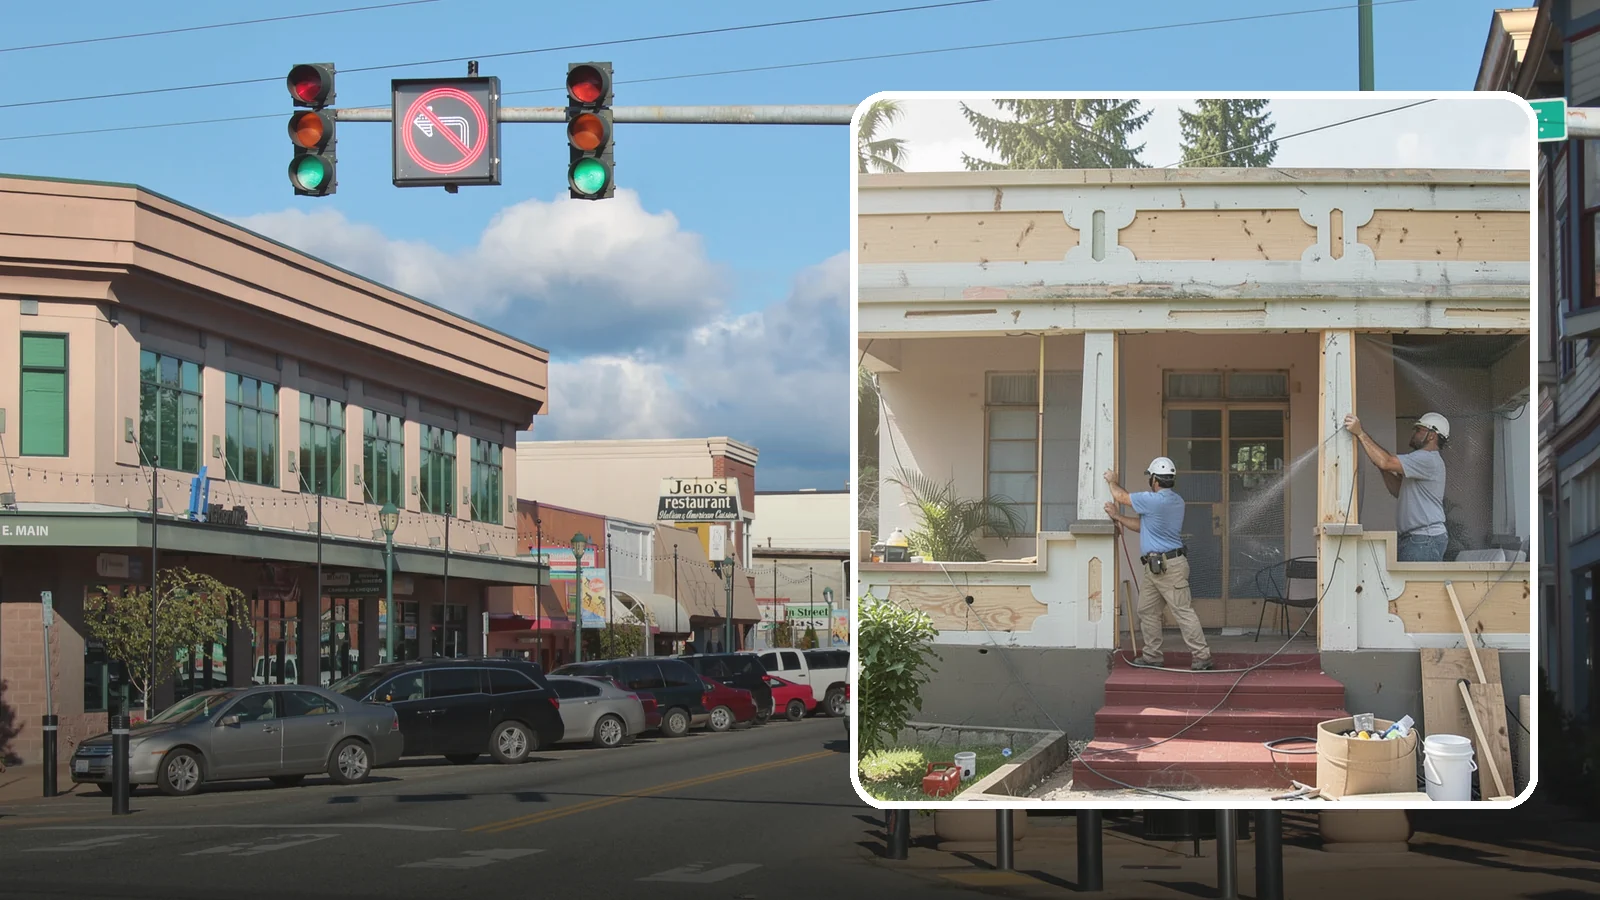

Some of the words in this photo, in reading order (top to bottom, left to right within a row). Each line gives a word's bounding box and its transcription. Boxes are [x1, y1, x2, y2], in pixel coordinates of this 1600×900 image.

[669, 480, 728, 494] Jeno's
[664, 496, 731, 509] restaurant
[715, 510, 738, 519] Cuisine
[2, 525, 13, 536] E.
[15, 525, 49, 536] MAIN
[797, 607, 828, 617] Street
[790, 619, 823, 627] lass
